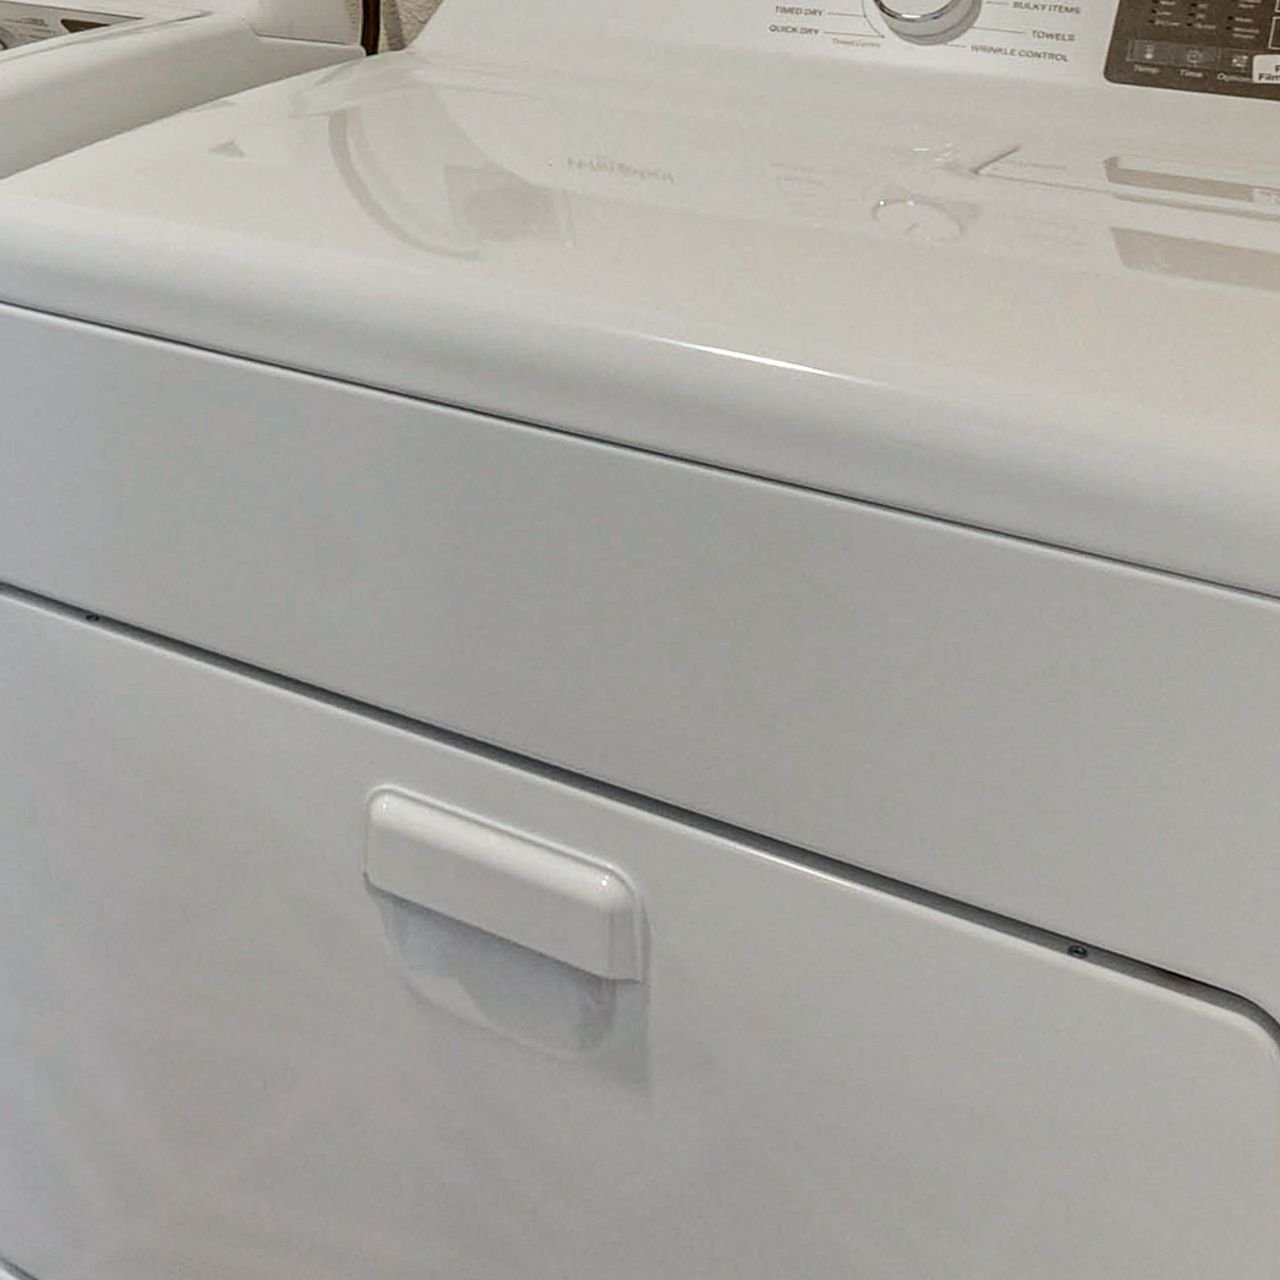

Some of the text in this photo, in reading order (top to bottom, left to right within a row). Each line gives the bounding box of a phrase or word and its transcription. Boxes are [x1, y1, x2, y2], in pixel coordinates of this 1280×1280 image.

[775, 6, 824, 17] TIMED DRY
[1012, 1, 1081, 15] BULKY ITEMS
[768, 24, 820, 36] QUICK DRY
[1032, 30, 1077, 42] TOWELS
[970, 45, 1069, 63] WRINKLE CONTROL
